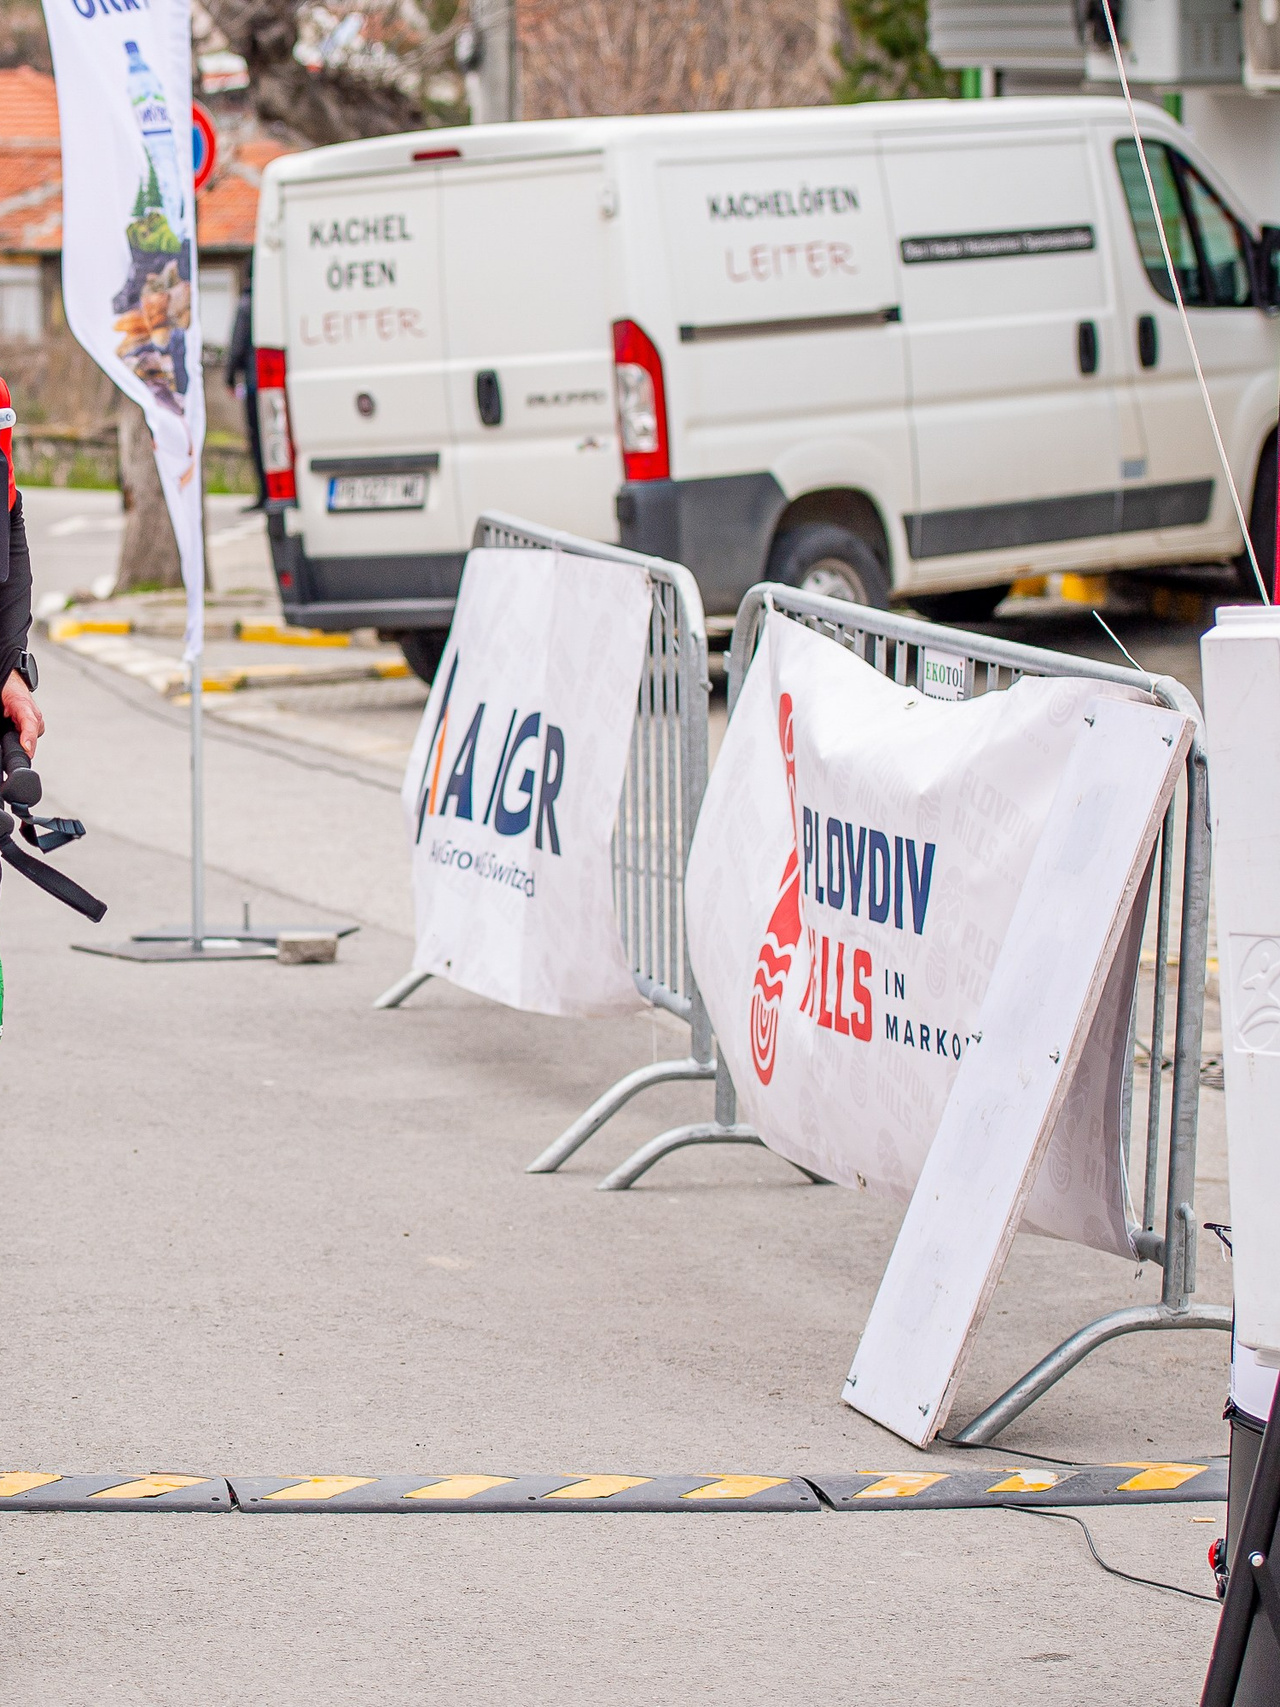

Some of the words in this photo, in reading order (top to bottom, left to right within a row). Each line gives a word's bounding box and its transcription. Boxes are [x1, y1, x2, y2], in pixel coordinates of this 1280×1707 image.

[309, 213, 412, 248] KACHEL
[725, 240, 859, 283] LEITER
[300, 307, 428, 347] LEITER
[885, 968, 905, 1000] IN
[885, 1013, 970, 1061] MARKO
